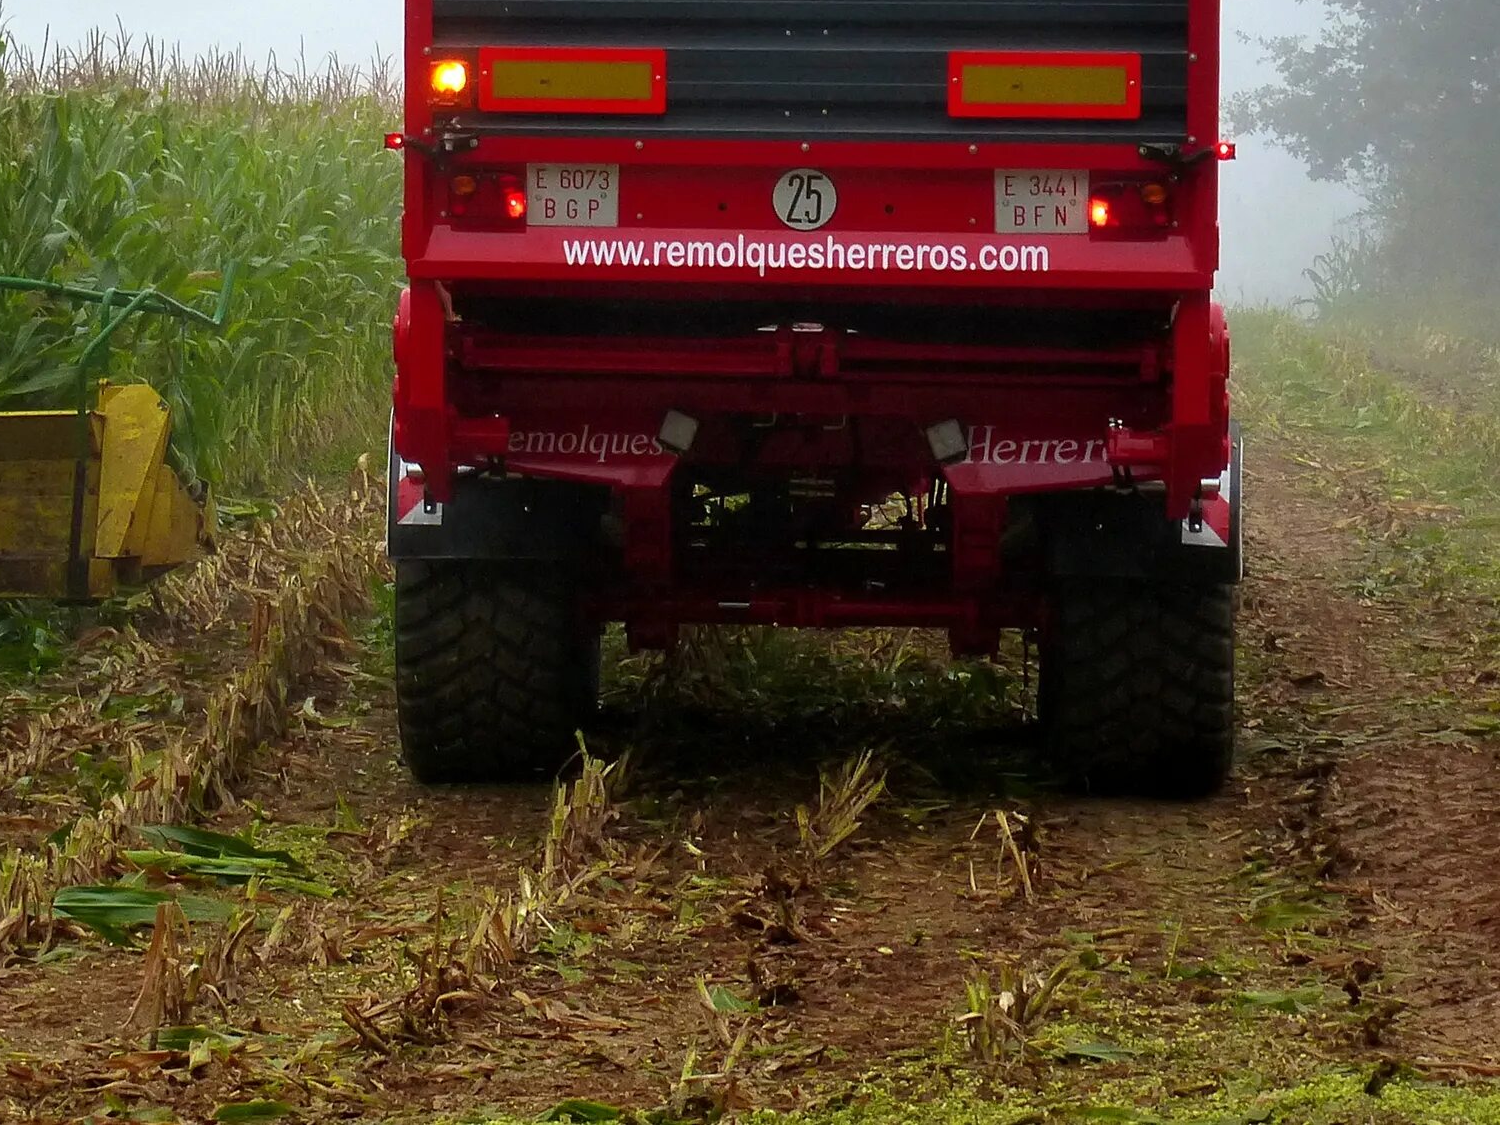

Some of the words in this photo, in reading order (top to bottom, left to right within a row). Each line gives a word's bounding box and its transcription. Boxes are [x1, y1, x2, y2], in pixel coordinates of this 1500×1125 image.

[536, 168, 548, 190] E
[560, 169, 610, 191] 6073
[1004, 175, 1016, 197] E
[1029, 175, 1078, 197] 3441
[786, 174, 824, 224] 25
[562, 233, 1051, 277] www.remolquesherreros.com
[507, 425, 664, 463] emolques
